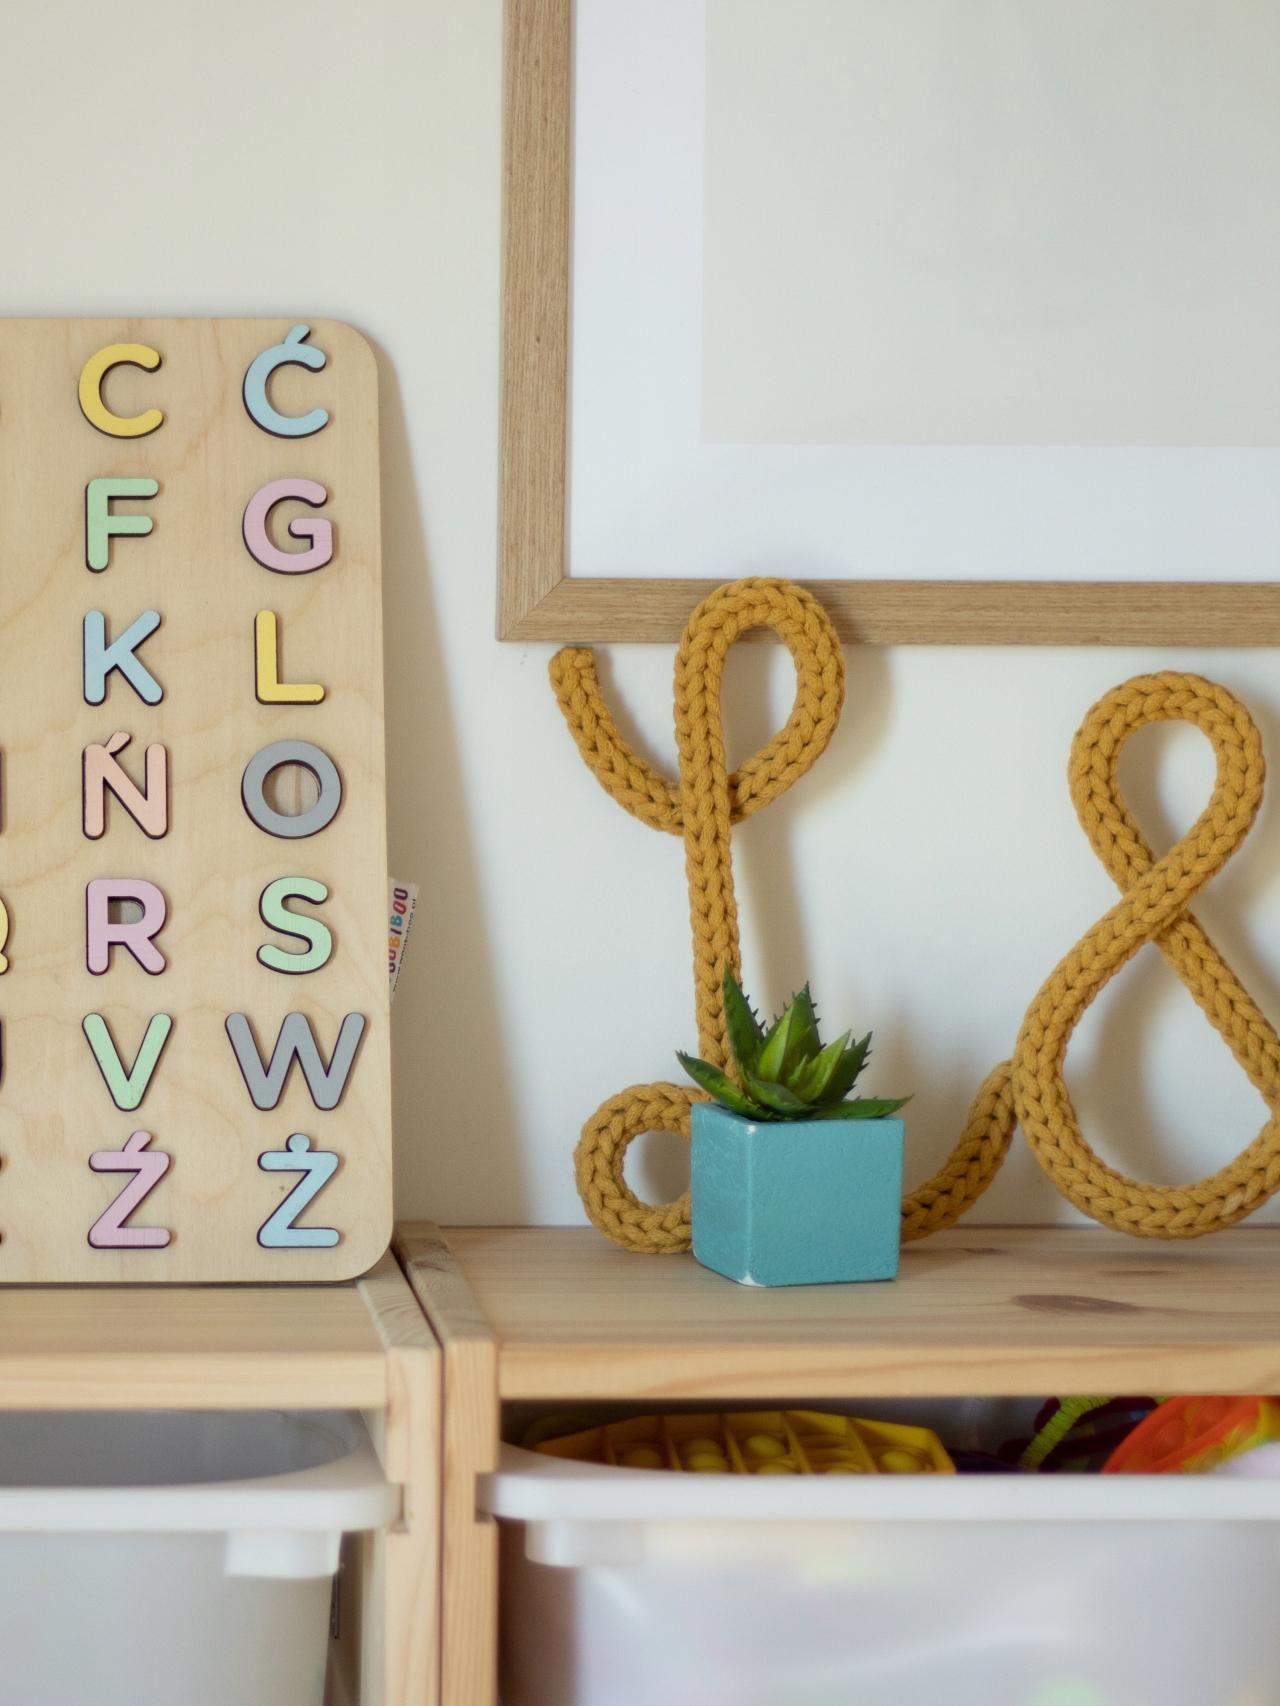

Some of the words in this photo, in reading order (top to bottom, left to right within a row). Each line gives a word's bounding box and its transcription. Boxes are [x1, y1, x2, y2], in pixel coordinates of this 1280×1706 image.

[78, 343, 164, 439] C
[242, 324, 330, 440] Ć
[84, 478, 162, 574] F
[241, 478, 338, 576] G
[82, 610, 166, 707] K
[253, 609, 329, 706] L
[81, 732, 171, 841] Ń
[240, 740, 346, 840] O
[85, 877, 171, 976] R
[256, 877, 338, 976] S
[81, 1012, 176, 1113] V
[224, 1013, 369, 1112] W
[87, 1130, 176, 1251] Ź
[256, 1133, 345, 1250] Ż
